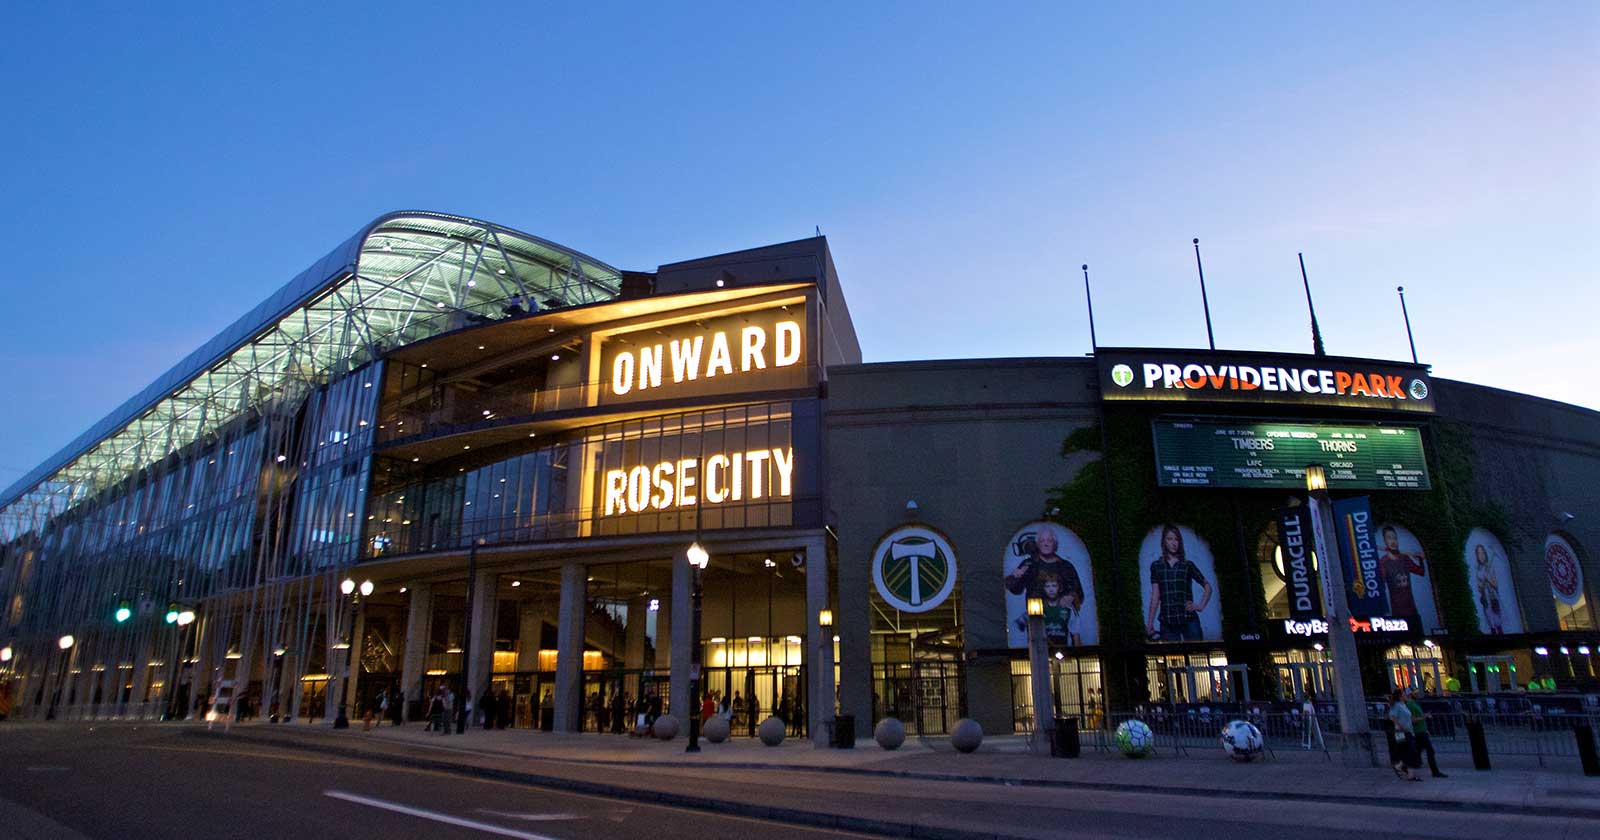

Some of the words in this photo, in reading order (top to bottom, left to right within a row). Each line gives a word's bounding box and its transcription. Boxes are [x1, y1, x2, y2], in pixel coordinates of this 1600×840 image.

[612, 321, 801, 395] ONWARD
[1231, 438, 1274, 450] TIMBERS
[1246, 459, 1263, 467] LAFC
[1318, 440, 1357, 452] THORNS
[605, 458, 697, 516] ROSE
[706, 447, 793, 503] CITY
[1353, 511, 1375, 559] DUTCH
[1285, 515, 1312, 611] DURACELL
[1361, 557, 1380, 598] BROS
[1370, 617, 1408, 632] Plaza
